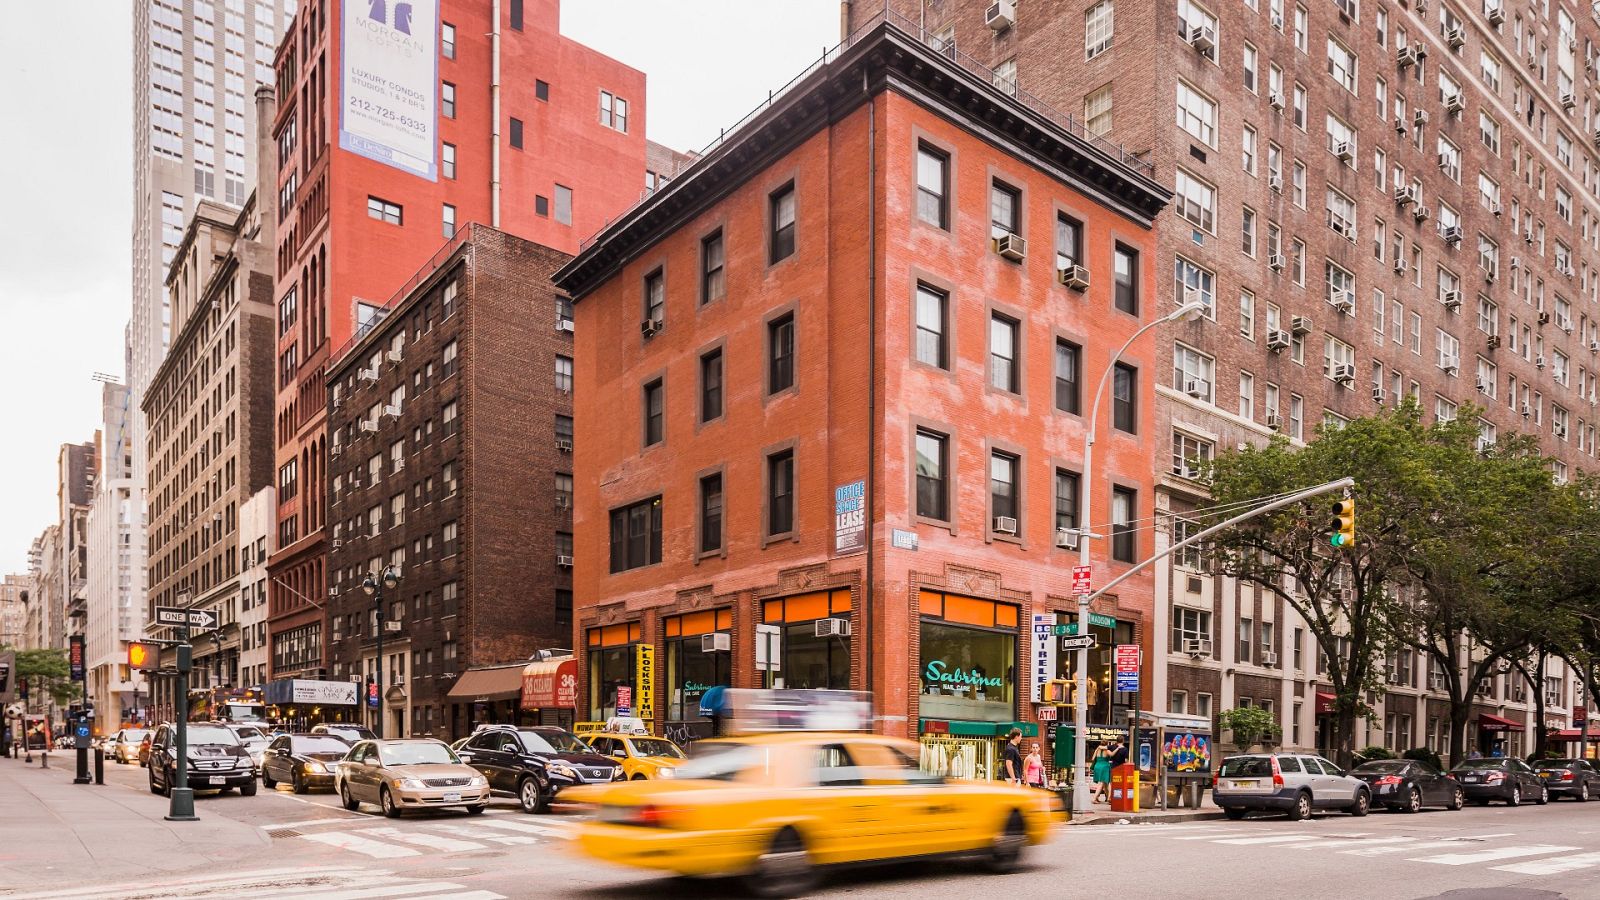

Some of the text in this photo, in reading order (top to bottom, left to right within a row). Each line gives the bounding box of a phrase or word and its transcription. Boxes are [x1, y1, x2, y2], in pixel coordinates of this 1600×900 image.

[355, 16, 424, 53] MORGAN
[366, 33, 412, 58] LOFTS
[352, 67, 425, 102] LUXURY CONDOS
[350, 96, 426, 133] 212-725-6333
[836, 481, 864, 502] OFFICE
[836, 498, 859, 515] SPACE
[836, 508, 865, 531] LEASE
[165, 612, 209, 623] ONE WAY
[1089, 614, 1111, 626] MADISON
[1055, 625, 1059, 634] E
[1062, 625, 1071, 634] 36
[926, 660, 1004, 687] Sabrina
[1037, 633, 1048, 700] WIRELE
[524, 677, 533, 695] 36
[561, 674, 575, 688] 36
[642, 653, 651, 710] LOCKSMITH
[684, 680, 712, 691] Sabrina
[1038, 709, 1057, 720] ATM
